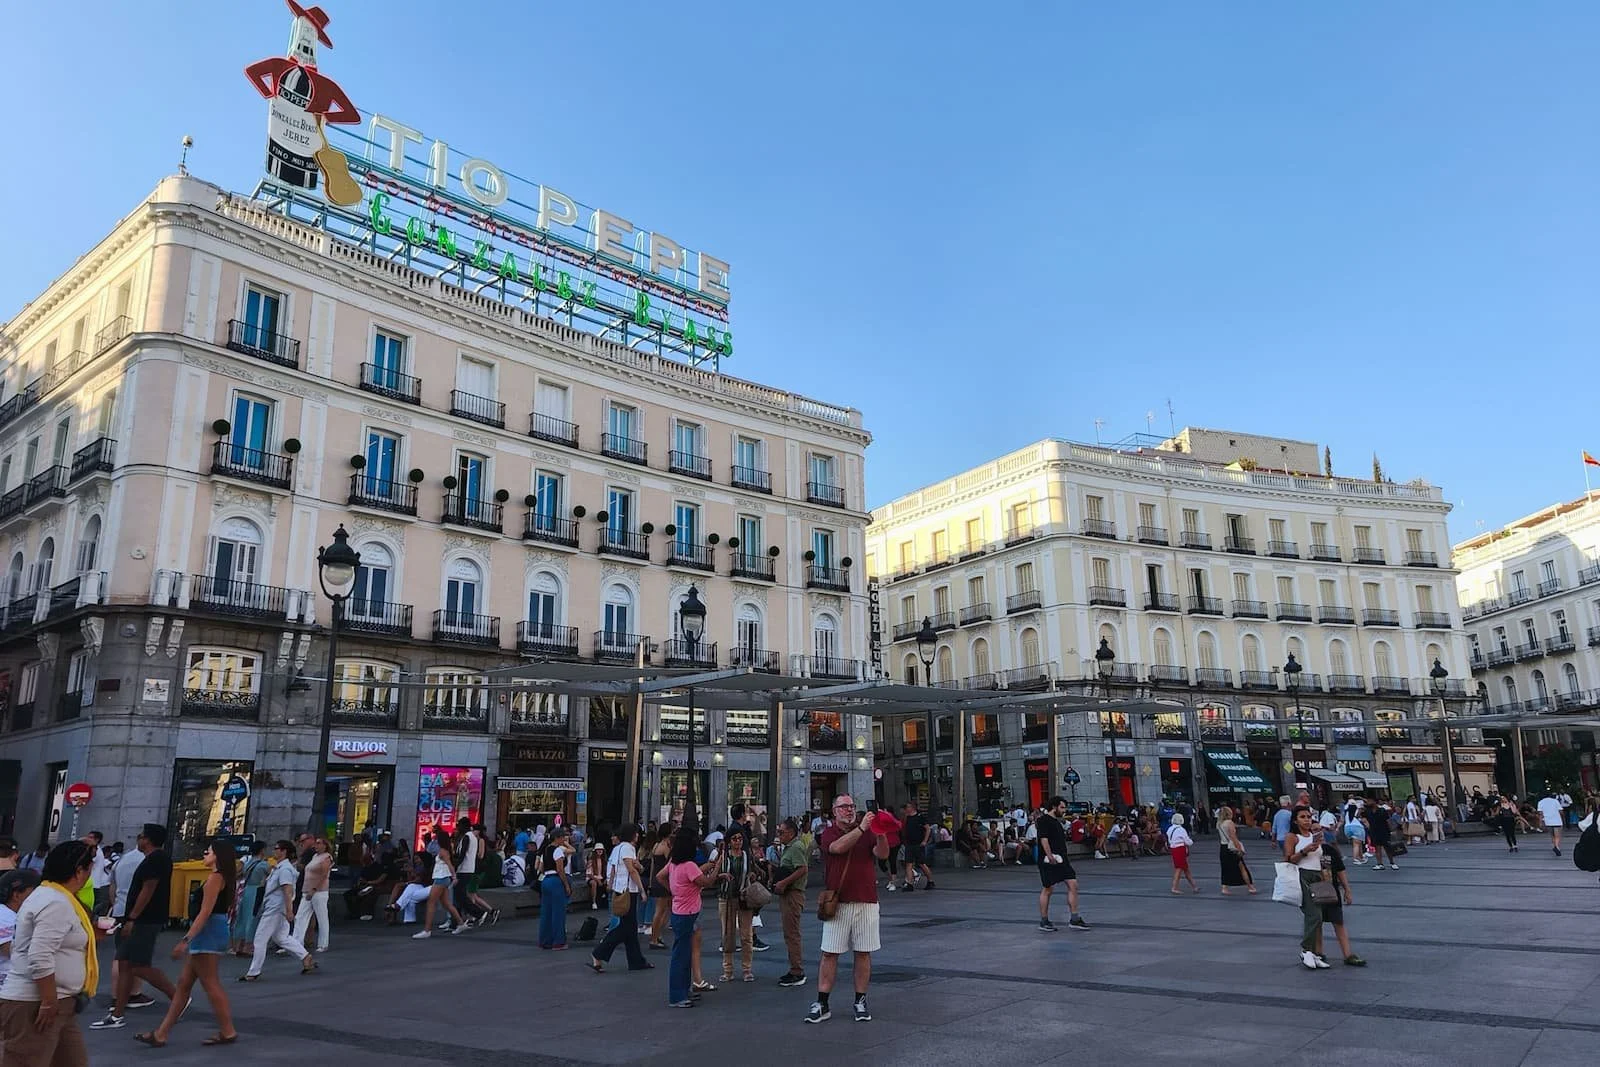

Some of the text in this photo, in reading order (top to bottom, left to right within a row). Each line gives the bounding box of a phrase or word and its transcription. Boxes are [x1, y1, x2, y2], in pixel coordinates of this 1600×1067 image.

[290, 94, 308, 109] PEP
[284, 129, 310, 146] JEREZ
[271, 146, 289, 160] FINO
[374, 112, 731, 305] TIO PEPE
[369, 191, 734, 357] GONZALEZ BYASS
[870, 582, 880, 634] HOTEL
[333, 740, 388, 752] PRIMOR
[519, 748, 566, 760] PALAZZO
[1208, 752, 1244, 760] CHANGE
[1403, 754, 1428, 762] CASA
[665, 759, 708, 768] SEPHRA
[1028, 764, 1048, 772] Orang
[1107, 761, 1131, 770] Oange
[1294, 760, 1324, 769] CHNGE
[501, 781, 581, 790] HELADOS ITALIANOS
